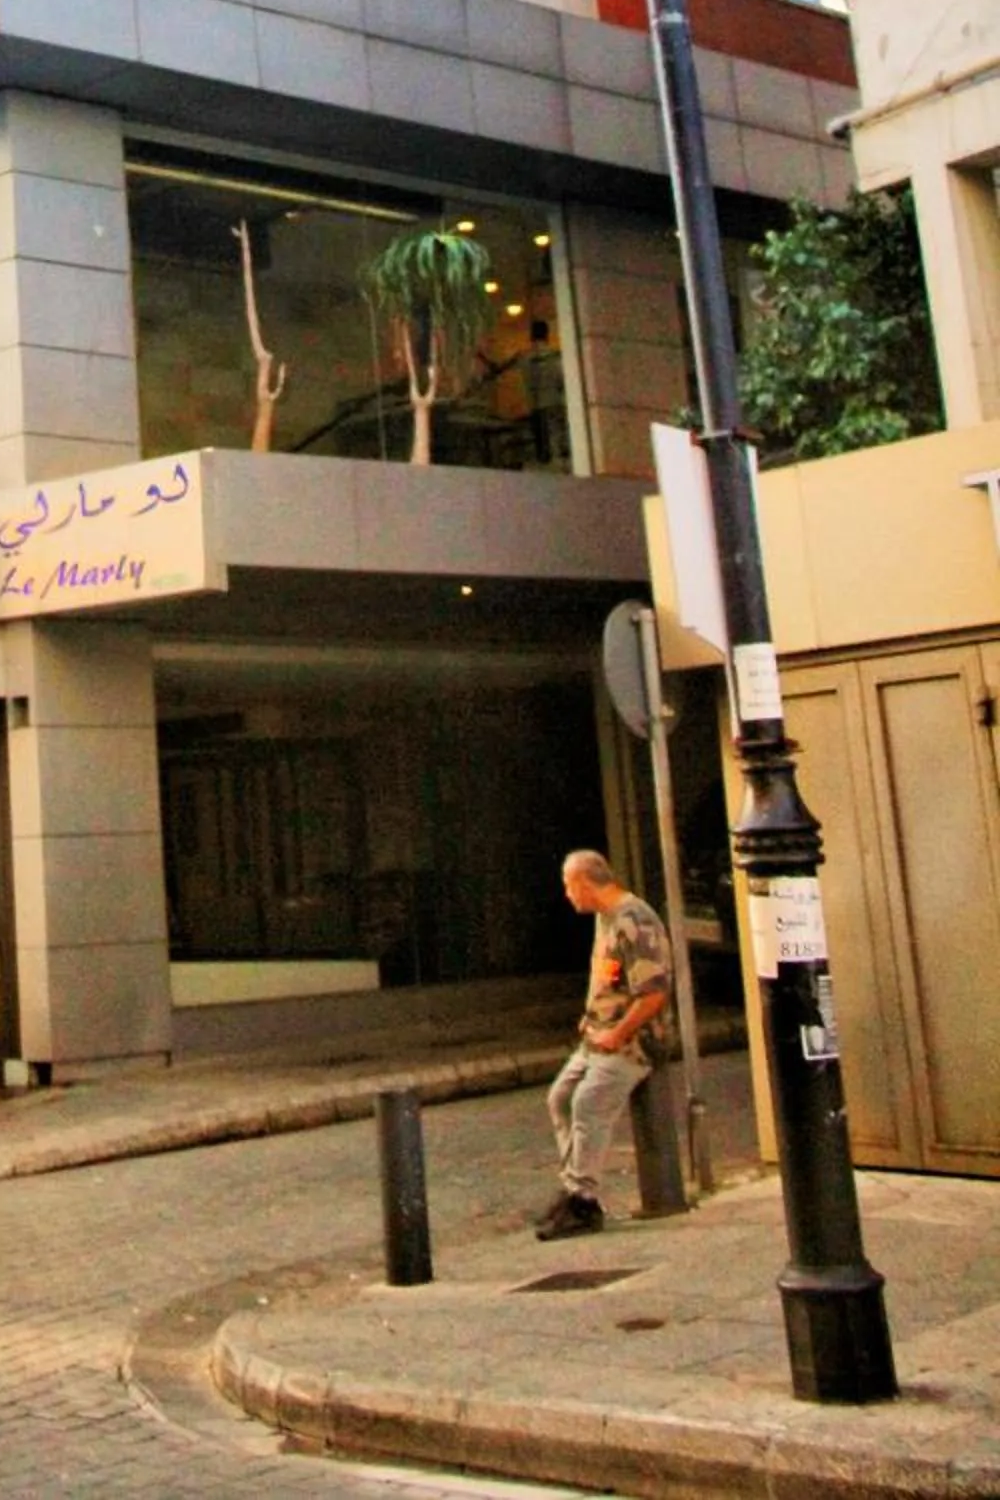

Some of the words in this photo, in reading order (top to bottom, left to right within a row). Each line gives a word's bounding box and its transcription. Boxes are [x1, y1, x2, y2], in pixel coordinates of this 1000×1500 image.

[131, 463, 189, 517] لو
[0, 566, 35, 597] Le
[40, 554, 146, 600] Marly
